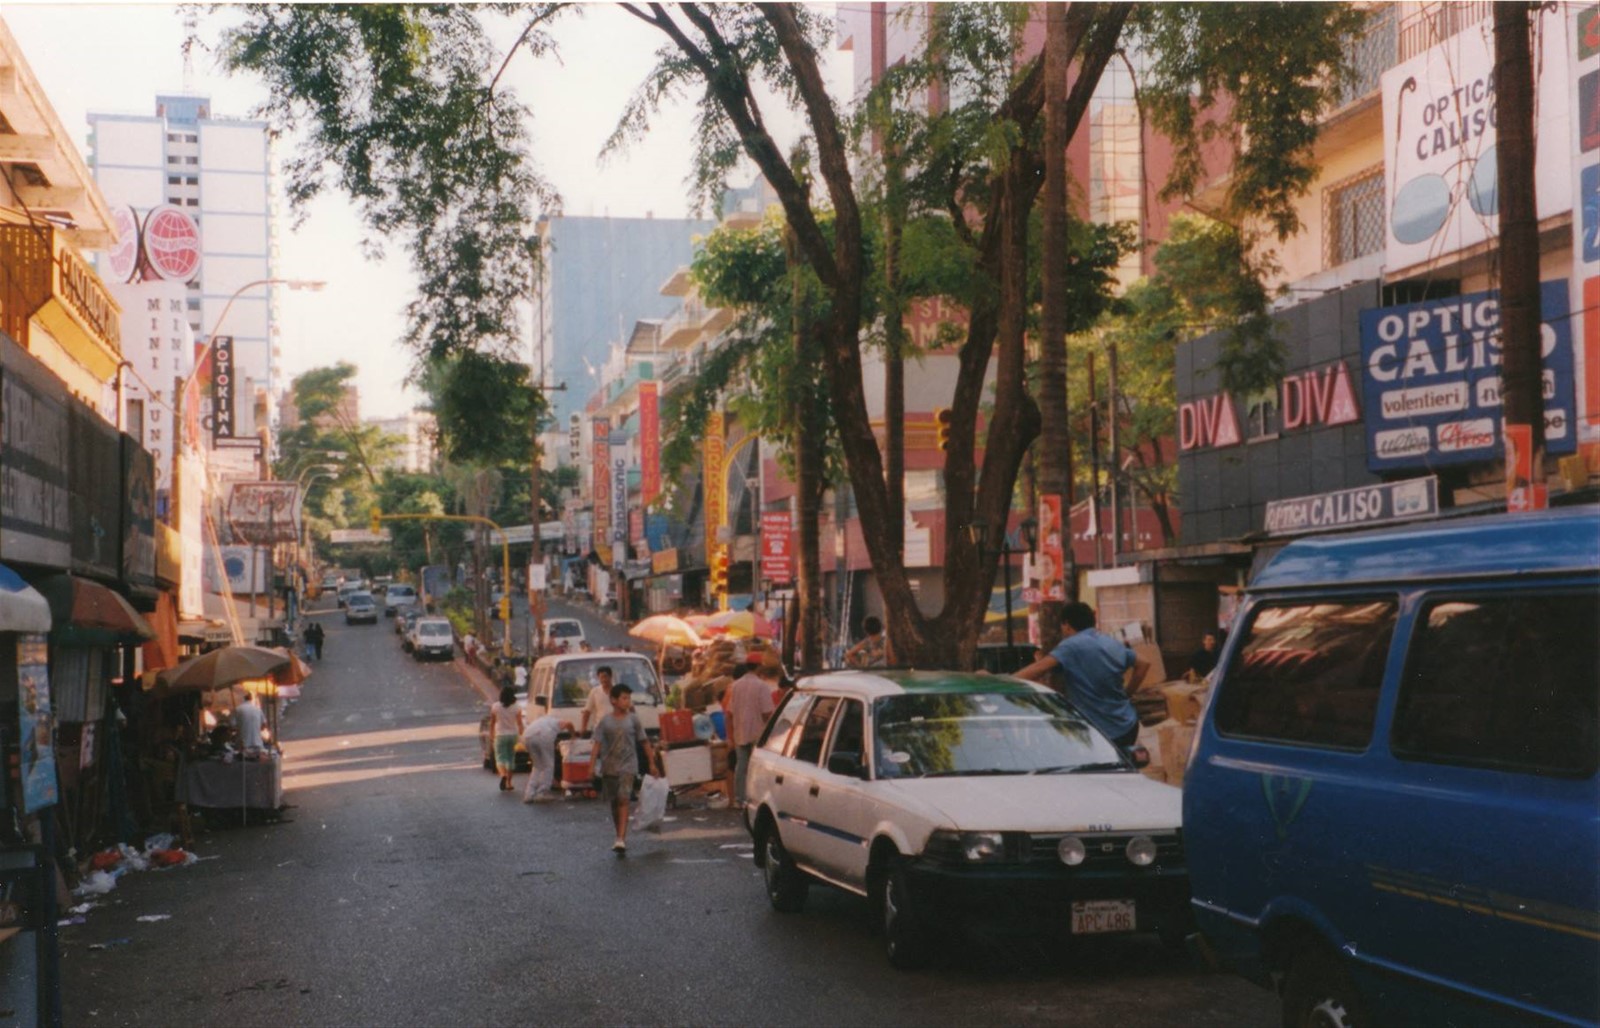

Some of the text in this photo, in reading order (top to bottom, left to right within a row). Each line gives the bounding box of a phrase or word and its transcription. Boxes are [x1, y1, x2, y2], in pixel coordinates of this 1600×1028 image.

[1378, 300, 1500, 342] OPTIC
[216, 337, 230, 435] FOTOKINA
[614, 459, 626, 542] Panasonic
[1311, 489, 1382, 525] CALISO
